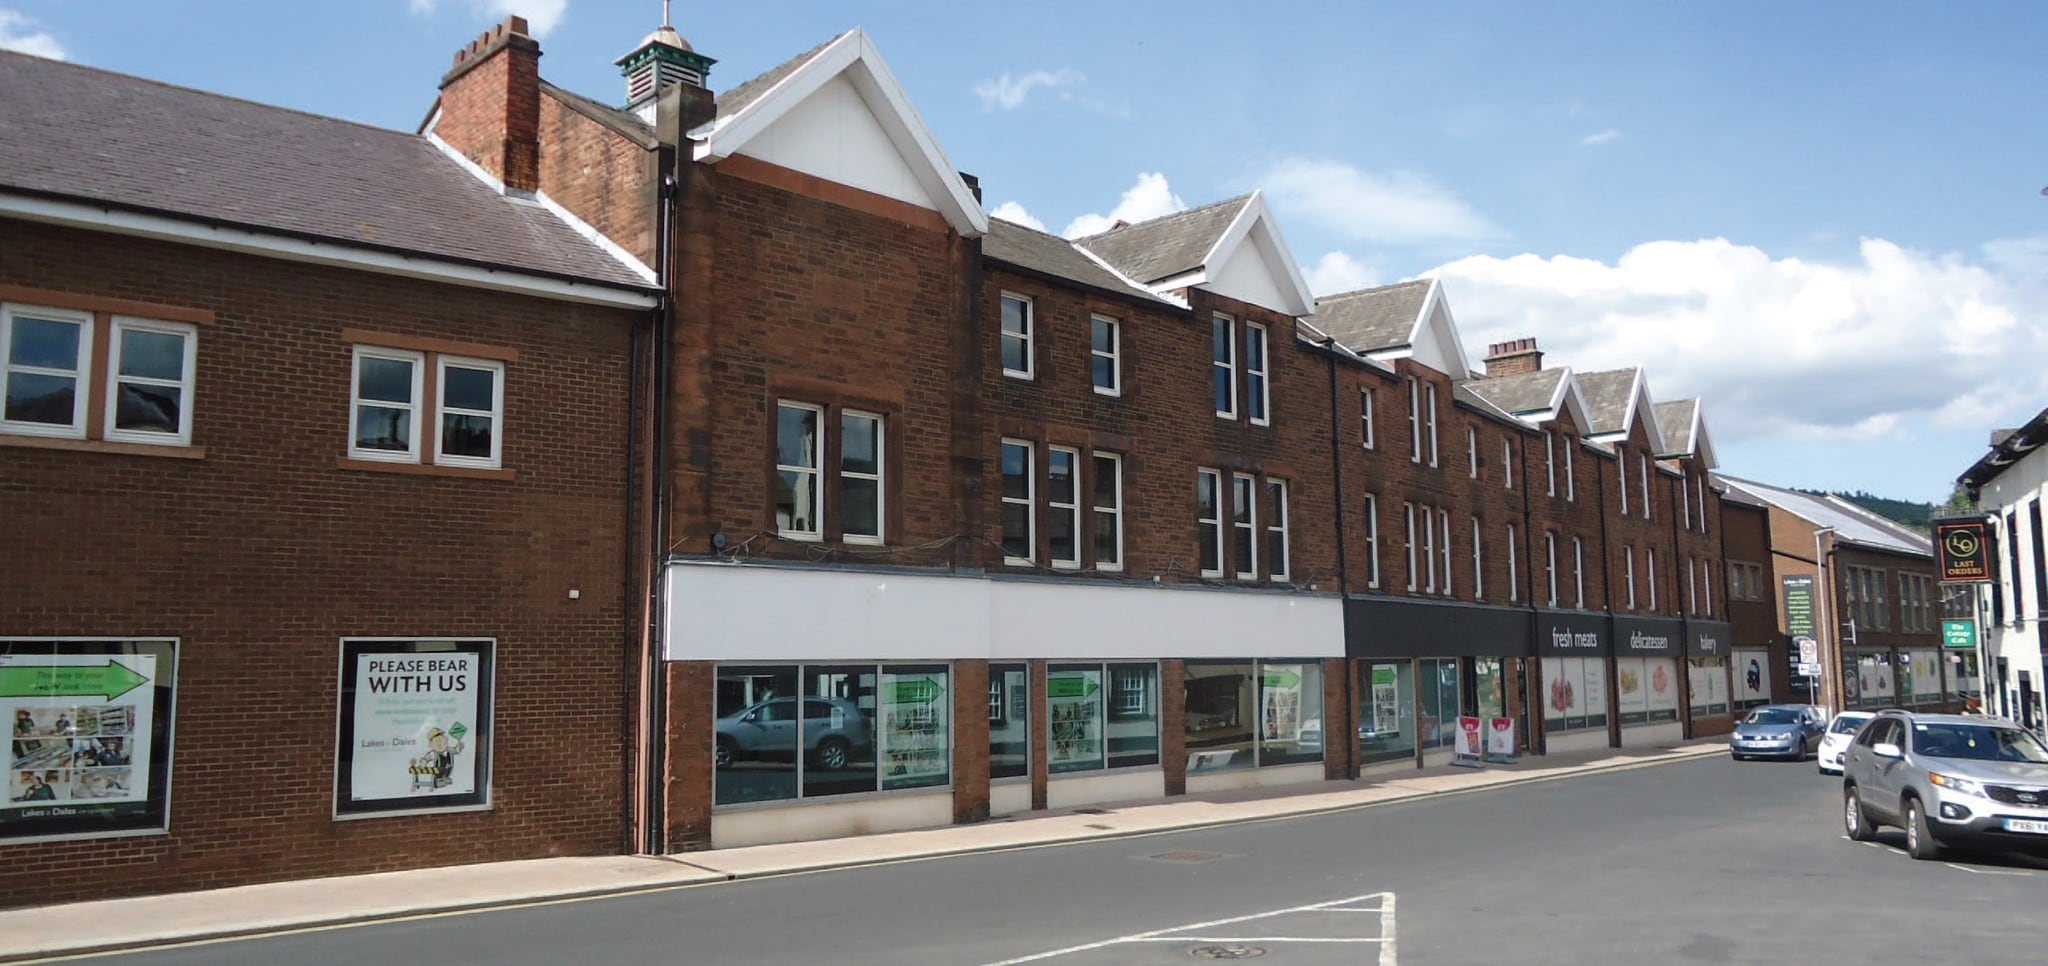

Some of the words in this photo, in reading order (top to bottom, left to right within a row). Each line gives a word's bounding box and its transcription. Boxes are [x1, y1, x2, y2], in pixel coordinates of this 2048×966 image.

[1948, 567, 1983, 576] ORDERS
[1552, 626, 1573, 648] fresh
[1574, 632, 1598, 648] meats
[1630, 629, 1668, 649] delicatessen
[1700, 633, 1716, 655] bakery
[369, 659, 425, 673] PLEASE
[428, 660, 467, 672] BEAR
[368, 675, 431, 694] WITH
[438, 674, 466, 692] US
[361, 738, 385, 748] Lakes
[392, 736, 417, 747] Dales
[21, 809, 45, 818] Lakes
[52, 807, 77, 816] Dales
